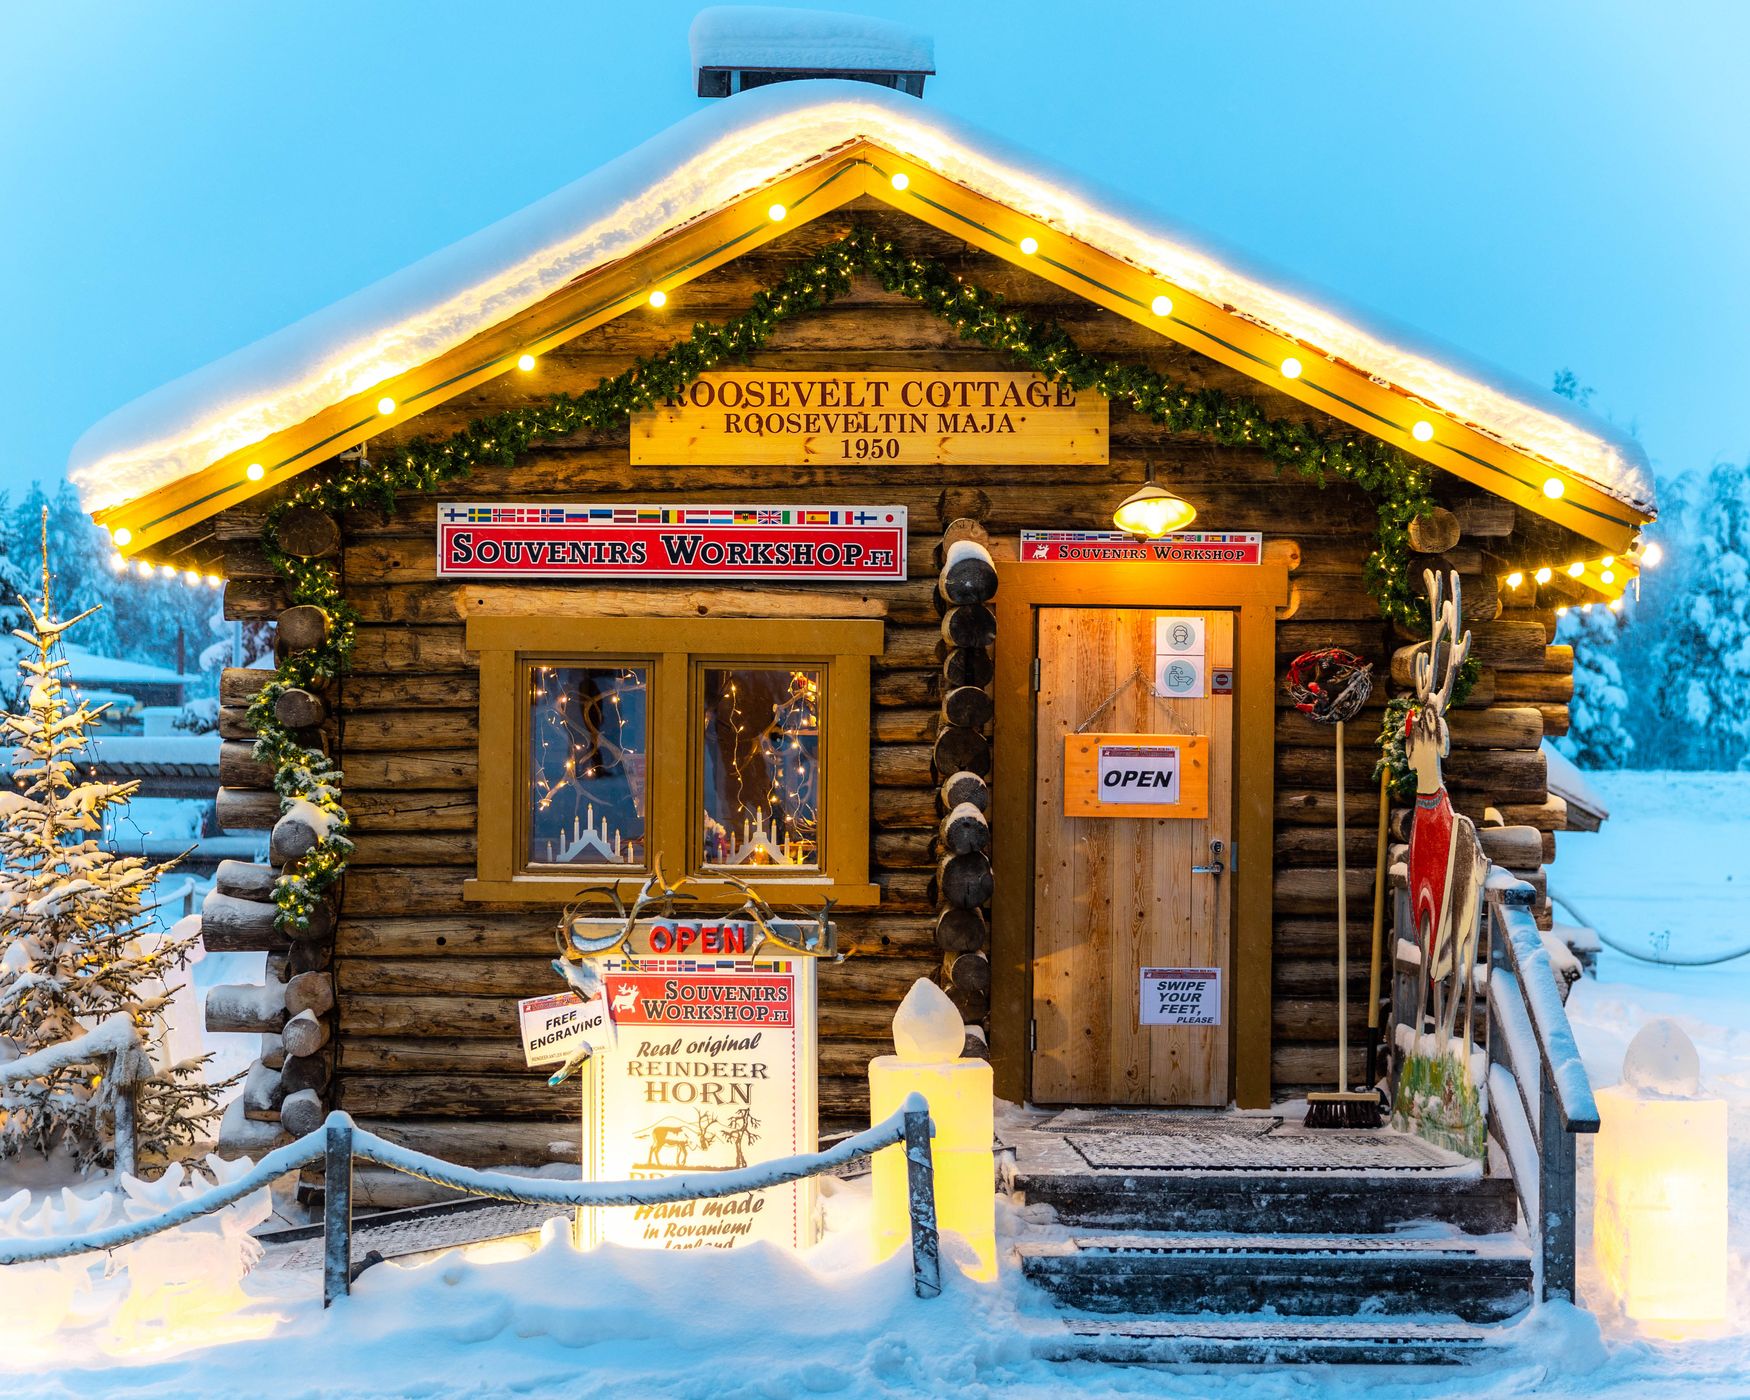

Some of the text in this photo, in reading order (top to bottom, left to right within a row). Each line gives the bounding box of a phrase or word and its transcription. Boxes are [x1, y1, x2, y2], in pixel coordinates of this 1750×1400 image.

[664, 380, 1076, 408] ROOSEVELT COTTAGE
[724, 413, 1016, 434] ROOSEVELTIN MAJA
[840, 438, 900, 459] 1950
[451, 532, 647, 564] SOUVENIRS
[1154, 546, 1245, 560] WORKSHOP
[1103, 770, 1173, 788] OPEN
[649, 925, 746, 953] OPEN
[665, 979, 788, 1001] SOUVENIRS
[1156, 981, 1206, 991] SWIPE
[1159, 993, 1202, 1002] YOUR
[545, 1010, 577, 1031] FREE
[1159, 1004, 1201, 1016] FEET,
[1176, 1016, 1214, 1024] PLEASE
[530, 1015, 603, 1051] ENGRAVING
[636, 1032, 762, 1057] Real original
[627, 1060, 770, 1080] REINDEER
[643, 1080, 754, 1106] HORN
[634, 1194, 765, 1220] Hand made
[643, 1217, 754, 1239] in Rovaniemi
